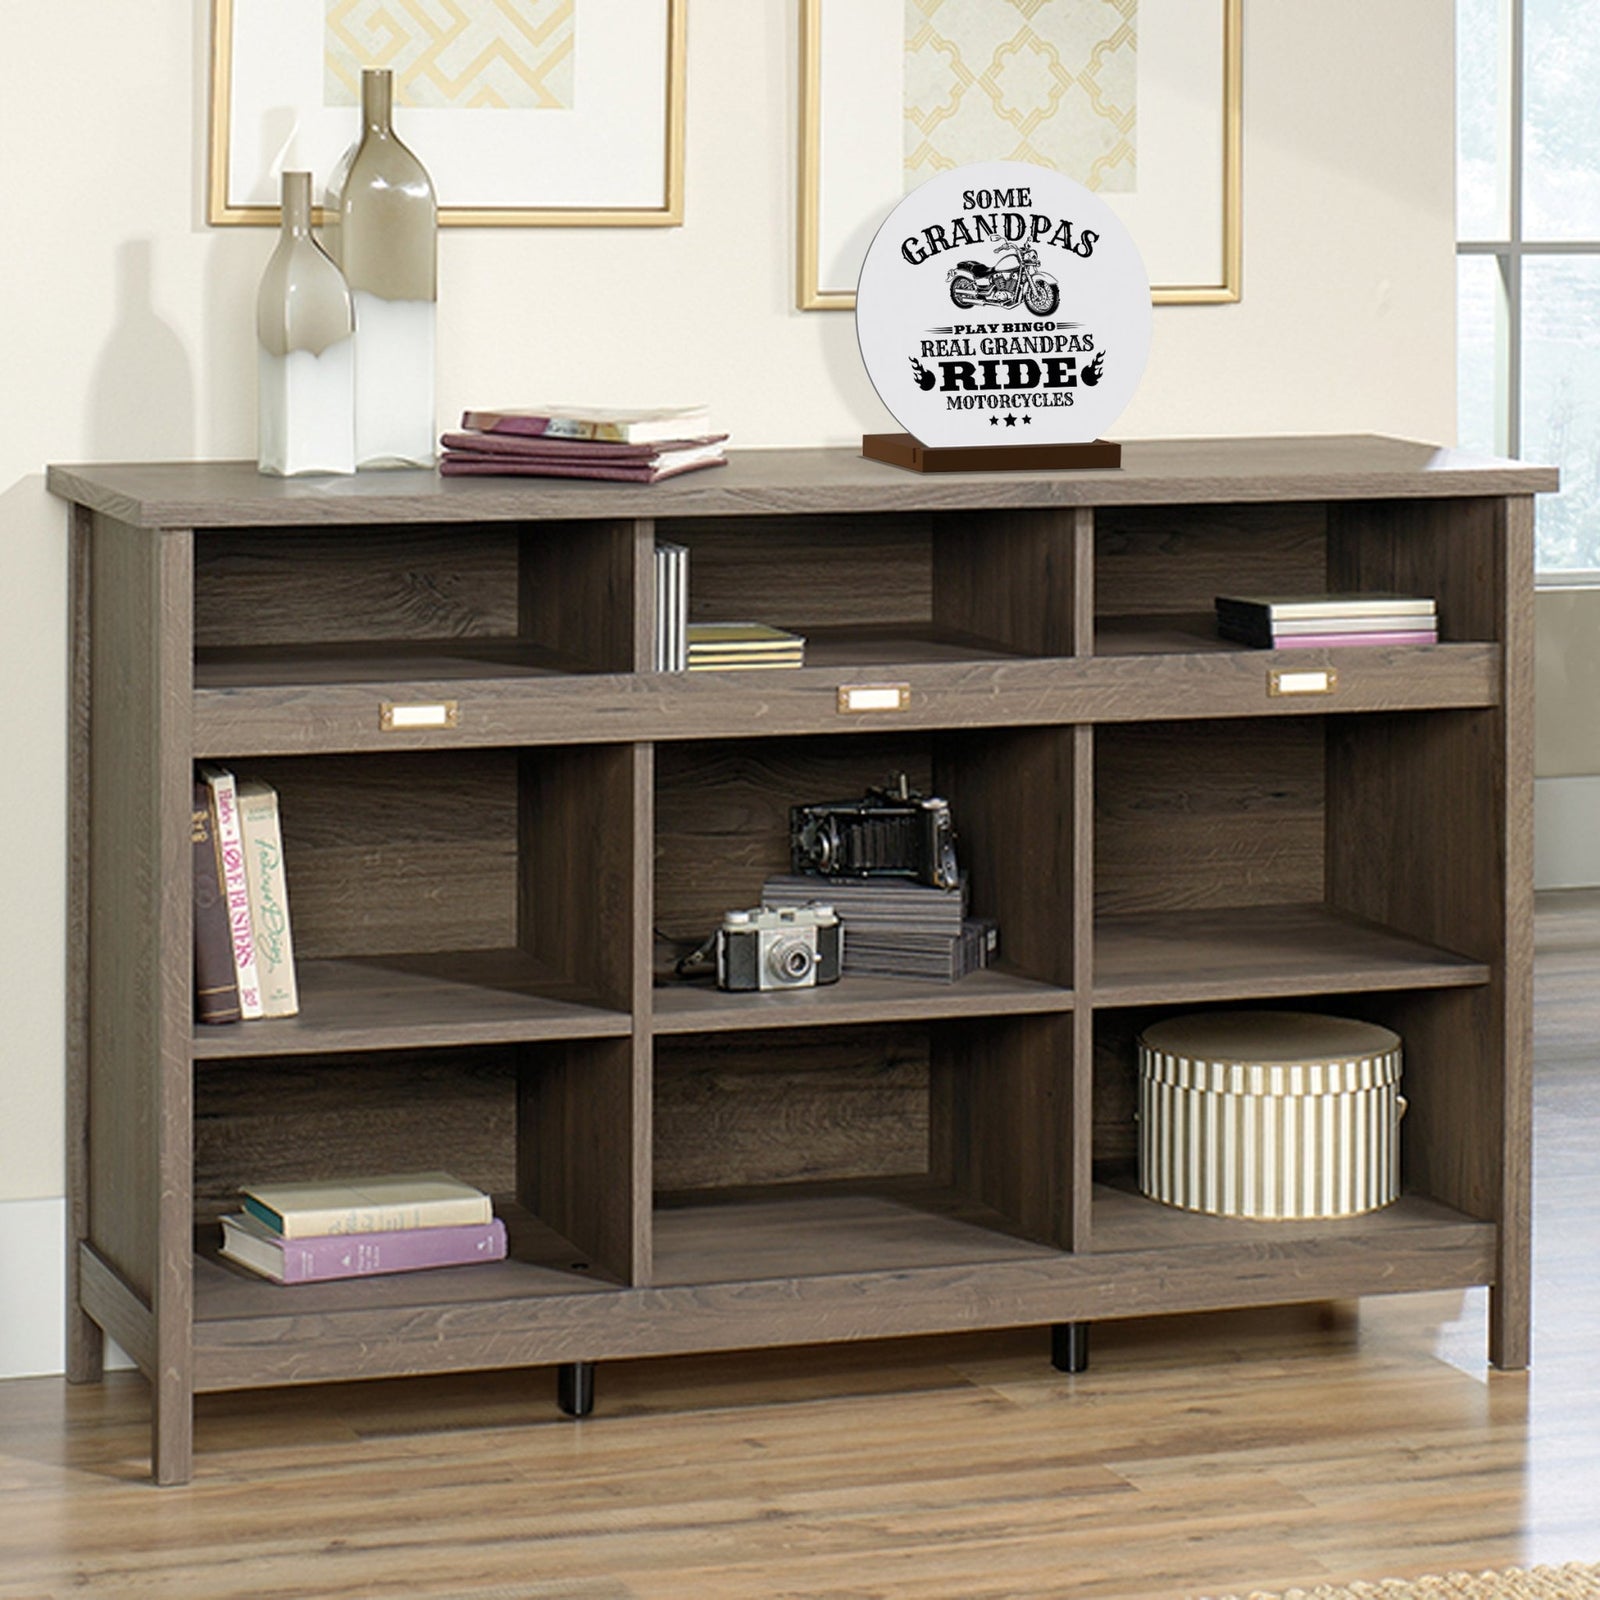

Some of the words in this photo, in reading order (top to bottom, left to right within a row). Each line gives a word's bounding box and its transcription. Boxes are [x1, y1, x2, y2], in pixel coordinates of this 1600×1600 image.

[962, 187, 1033, 210] SOME
[900, 212, 1100, 265] GRANDPAS
[953, 322, 1000, 335] PLAY
[1002, 321, 1056, 334] BINGO
[920, 338, 977, 358] REAL
[980, 334, 1095, 356] GRANDPAS
[938, 357, 1078, 392] RIDE
[946, 391, 1075, 411] MOTORCYCLES
